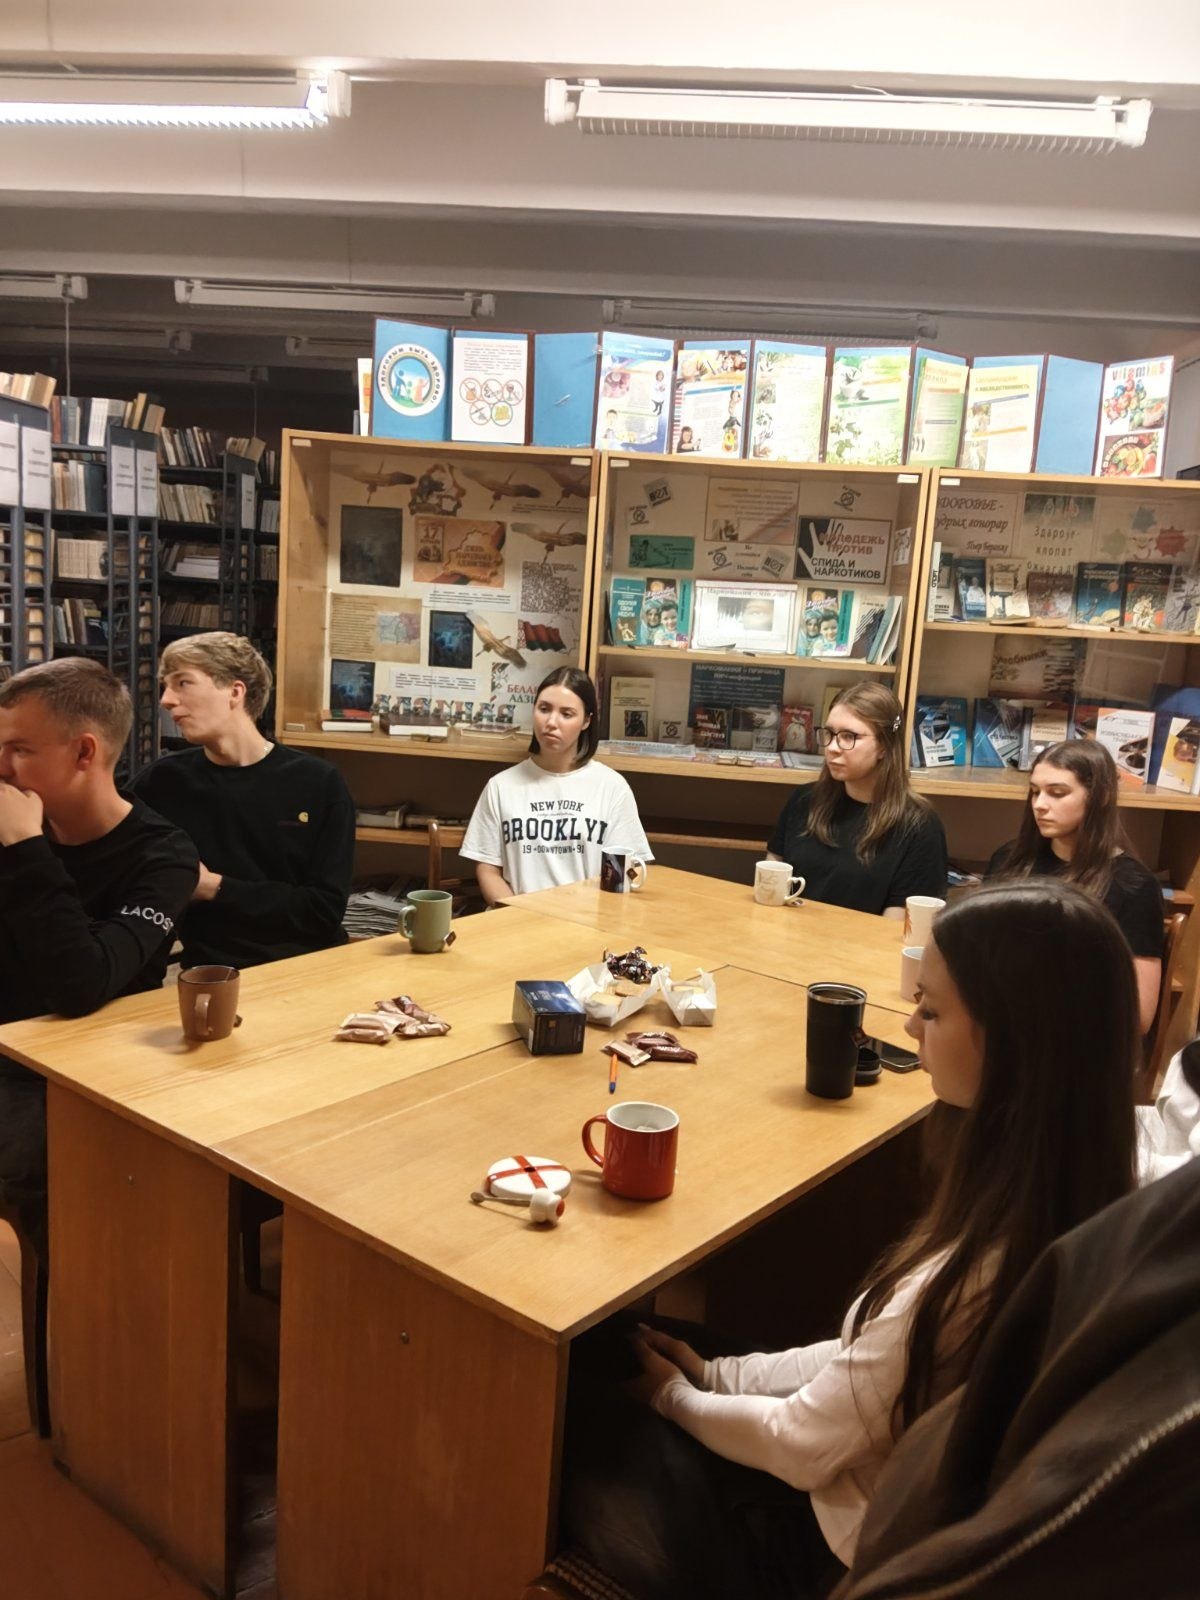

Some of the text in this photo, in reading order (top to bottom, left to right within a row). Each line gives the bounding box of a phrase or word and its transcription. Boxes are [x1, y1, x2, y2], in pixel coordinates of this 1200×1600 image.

[381, 347, 404, 387] ЗДОРОВЫМ
[409, 347, 429, 359] БЫТЬ
[424, 526, 439, 540] 17
[828, 544, 873, 555] ПРОТИВ
[811, 558, 855, 568] СПИДА И
[814, 567, 881, 579] НАРКОТИКОВ
[530, 800, 584, 812] NEW YORK
[523, 844, 532, 854] 19
